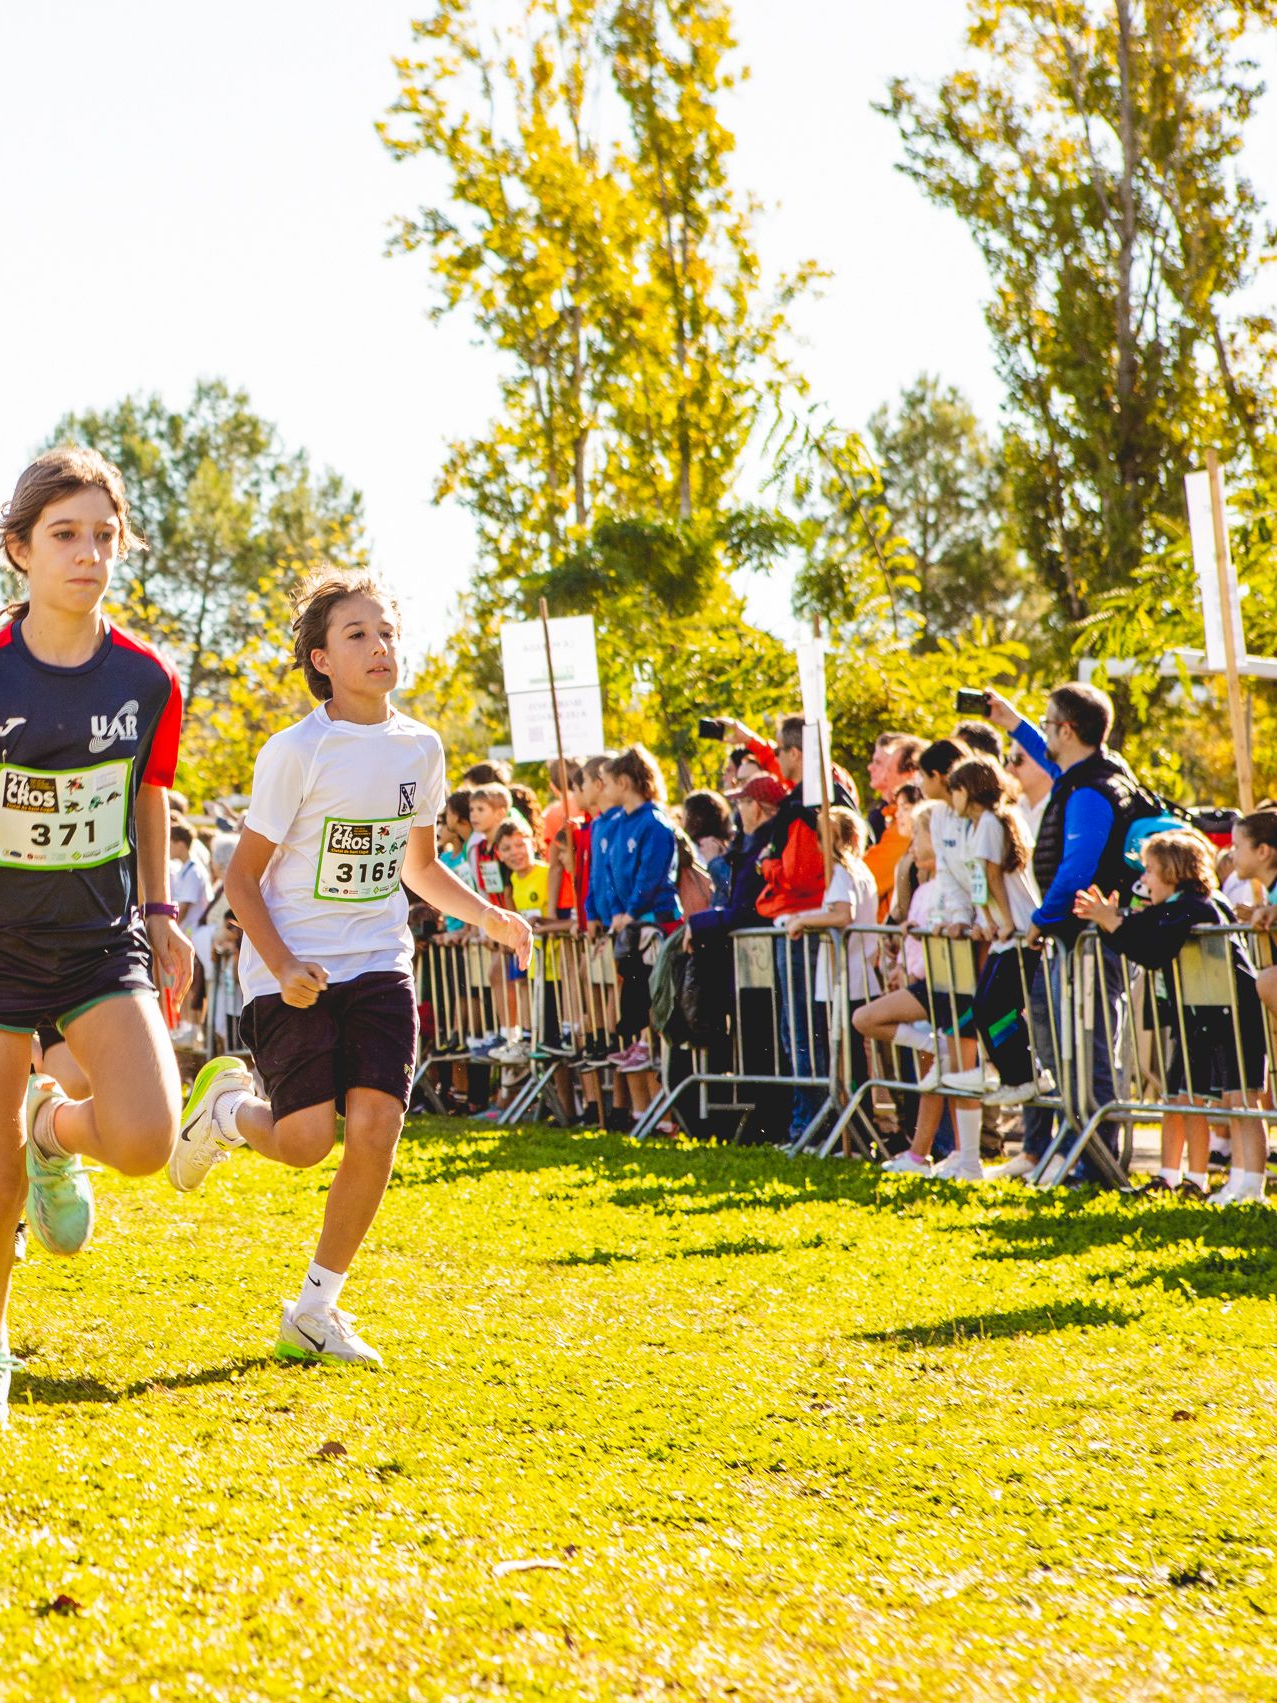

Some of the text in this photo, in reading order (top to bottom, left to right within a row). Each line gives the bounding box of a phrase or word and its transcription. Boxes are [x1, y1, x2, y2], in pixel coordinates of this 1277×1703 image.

[90, 714, 137, 736] UAR
[6, 788, 55, 807] CROS
[31, 820, 95, 847] 371
[332, 837, 370, 850] CROS
[336, 860, 397, 883] 3165
